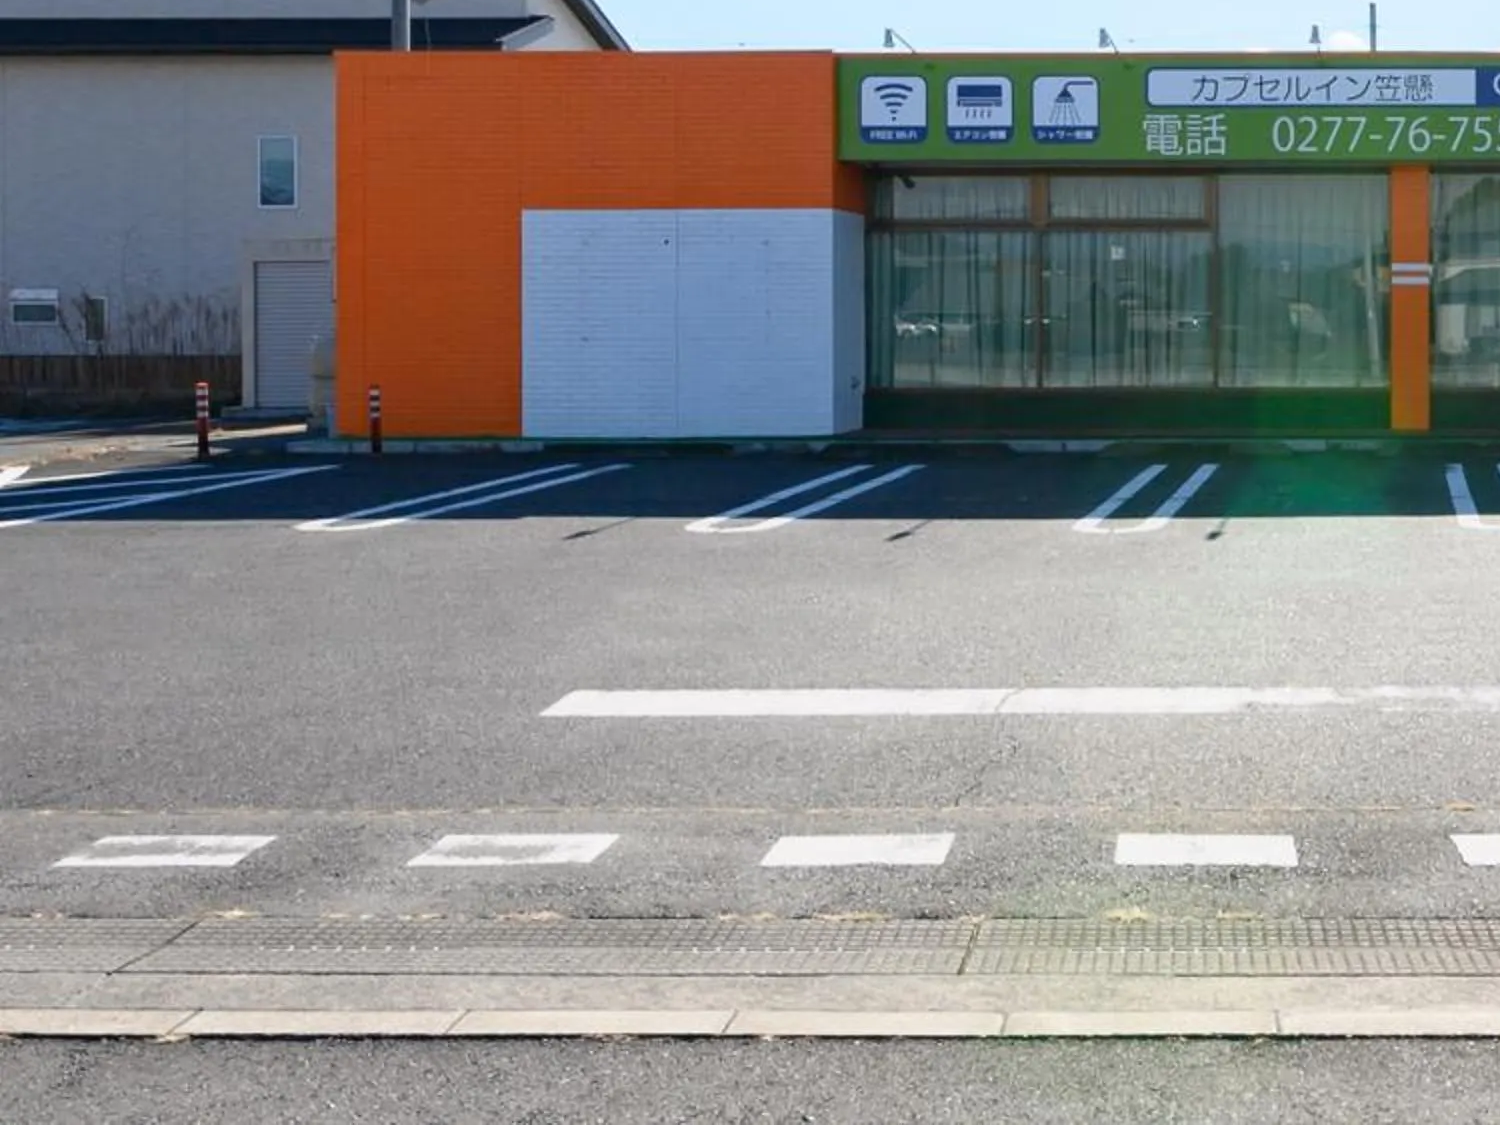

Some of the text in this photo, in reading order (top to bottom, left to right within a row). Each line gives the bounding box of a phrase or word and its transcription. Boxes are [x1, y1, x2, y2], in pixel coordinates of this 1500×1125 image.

[1192, 74, 1433, 102] カプセルイン笠懸
[1142, 113, 1228, 156] 電話
